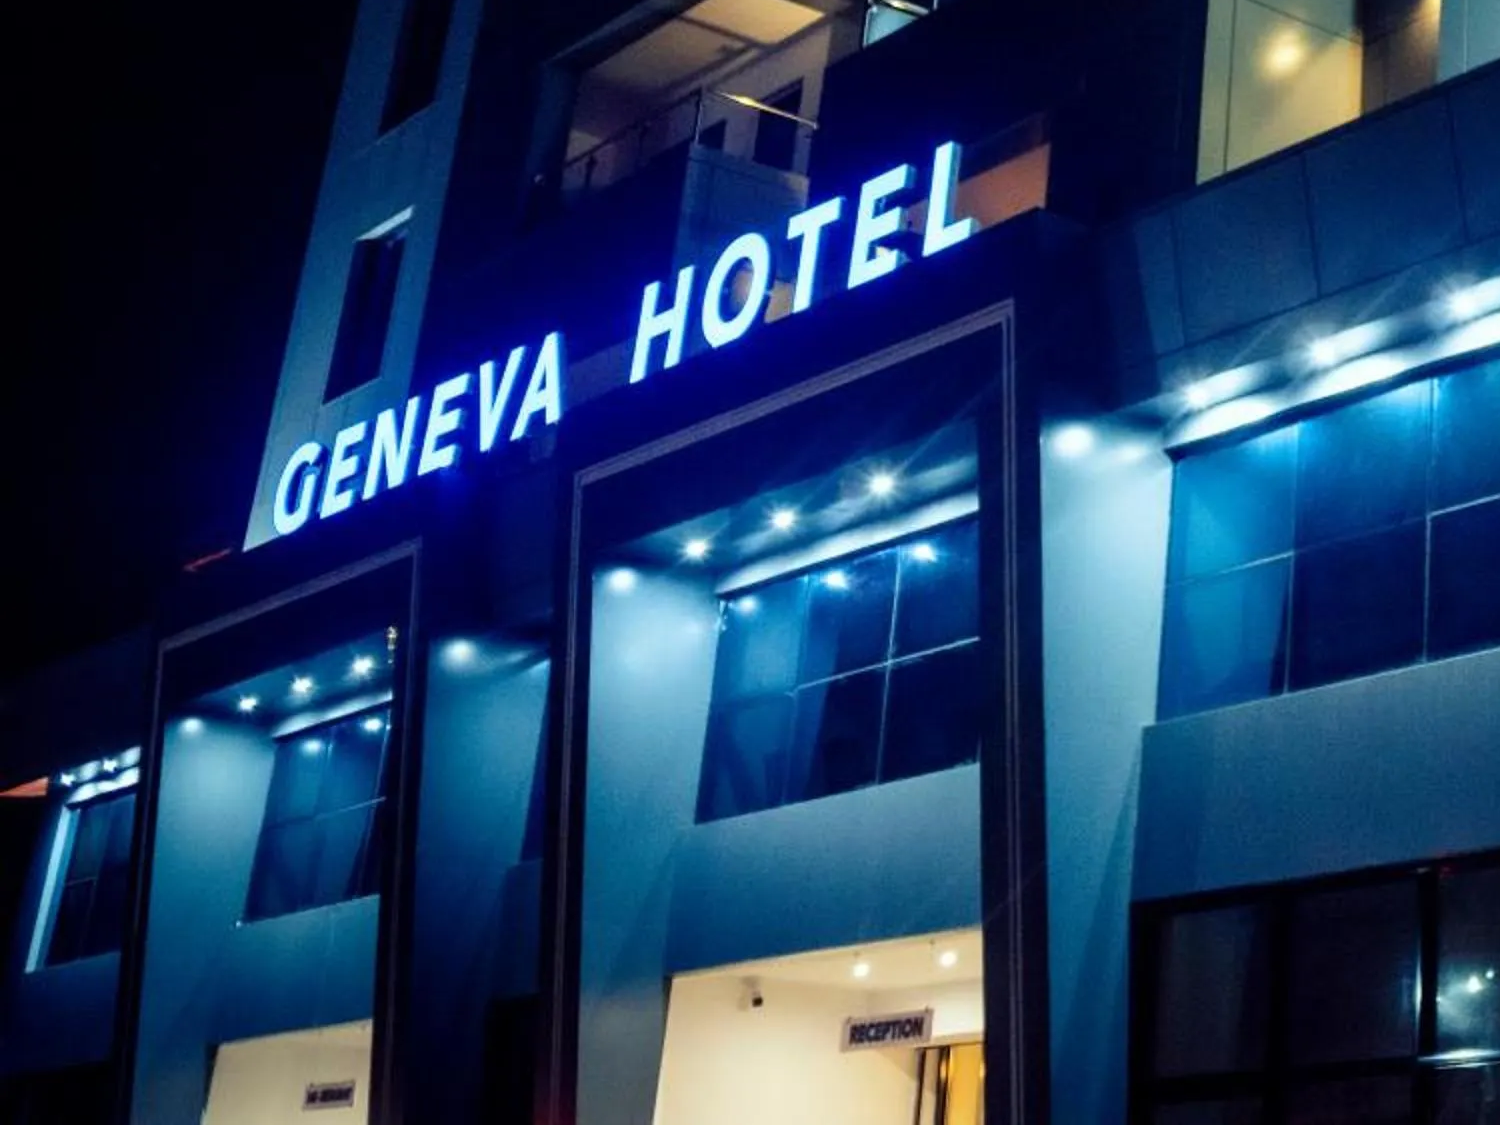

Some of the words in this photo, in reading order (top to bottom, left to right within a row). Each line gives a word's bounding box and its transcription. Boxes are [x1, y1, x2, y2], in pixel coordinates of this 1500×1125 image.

[272, 330, 564, 536] GENEVA
[628, 140, 977, 384] HOTEL
[849, 1016, 924, 1045] RECEPTION
